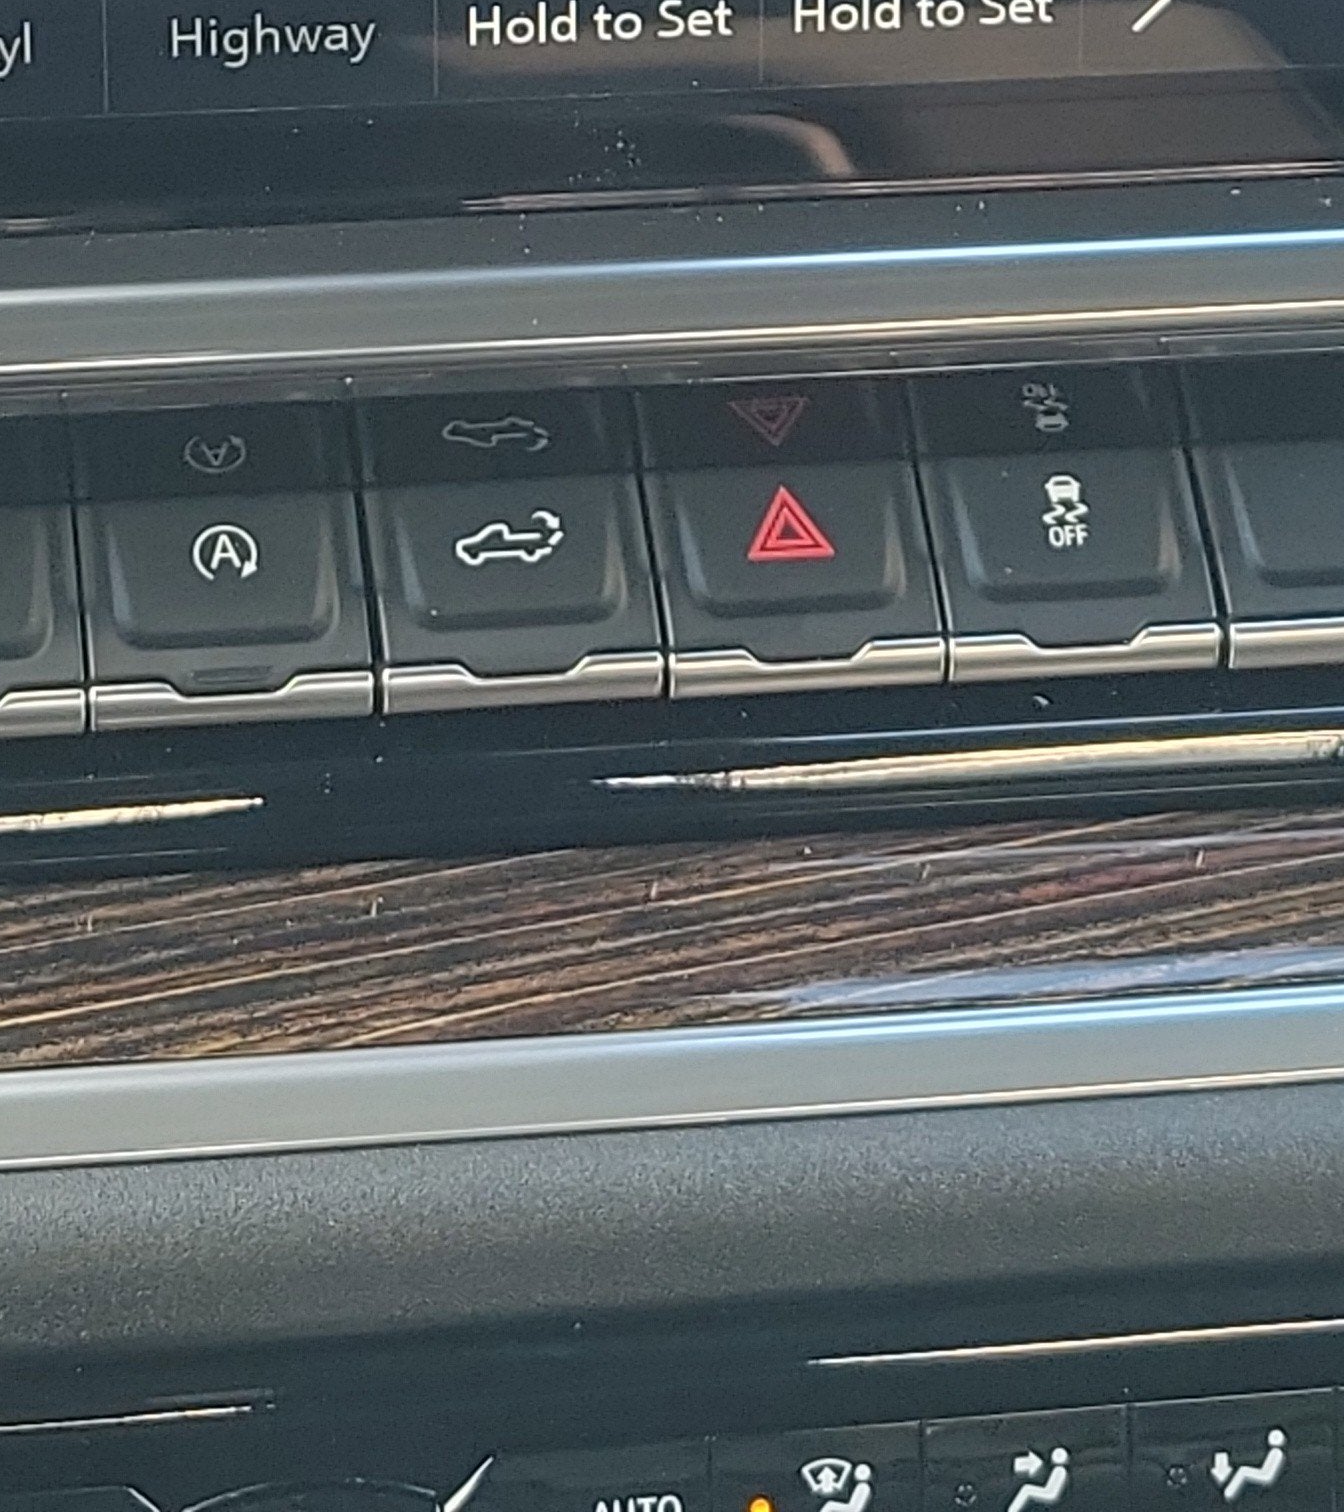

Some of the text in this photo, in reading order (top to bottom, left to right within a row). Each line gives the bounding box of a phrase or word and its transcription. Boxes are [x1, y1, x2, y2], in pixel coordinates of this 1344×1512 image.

[172, 13, 375, 68] Highway
[469, 0, 733, 46] Hold to Set
[1048, 524, 1088, 547] OFF
